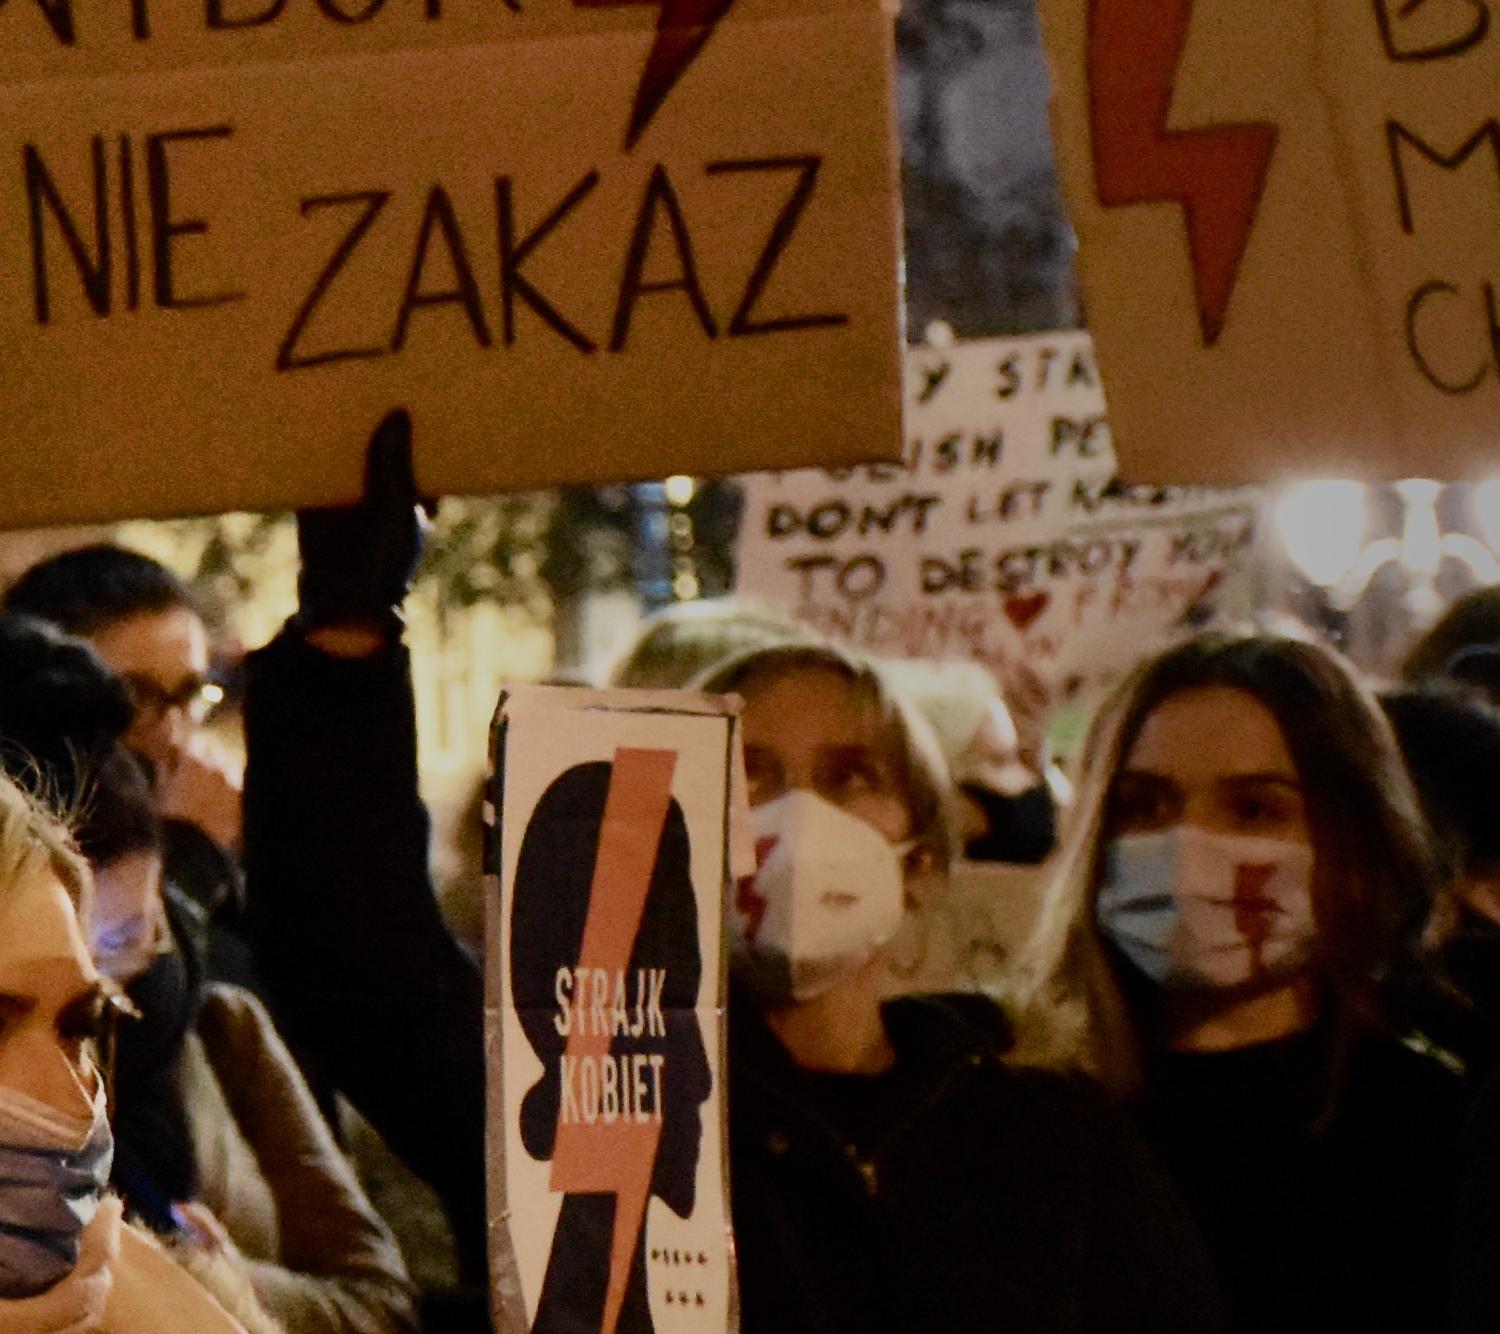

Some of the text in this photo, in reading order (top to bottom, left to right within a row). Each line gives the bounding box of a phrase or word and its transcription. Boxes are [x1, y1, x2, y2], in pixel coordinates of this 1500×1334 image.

[22, 123, 849, 373] NIE ZAKAZ
[916, 357, 950, 402] Y
[765, 489, 946, 543] DON'T
[963, 478, 1052, 527] LET
[782, 550, 889, 603] TO
[918, 535, 1142, 598] DESTROY
[553, 965, 667, 1038] STRAJK
[560, 1053, 664, 1126] KOBIET
